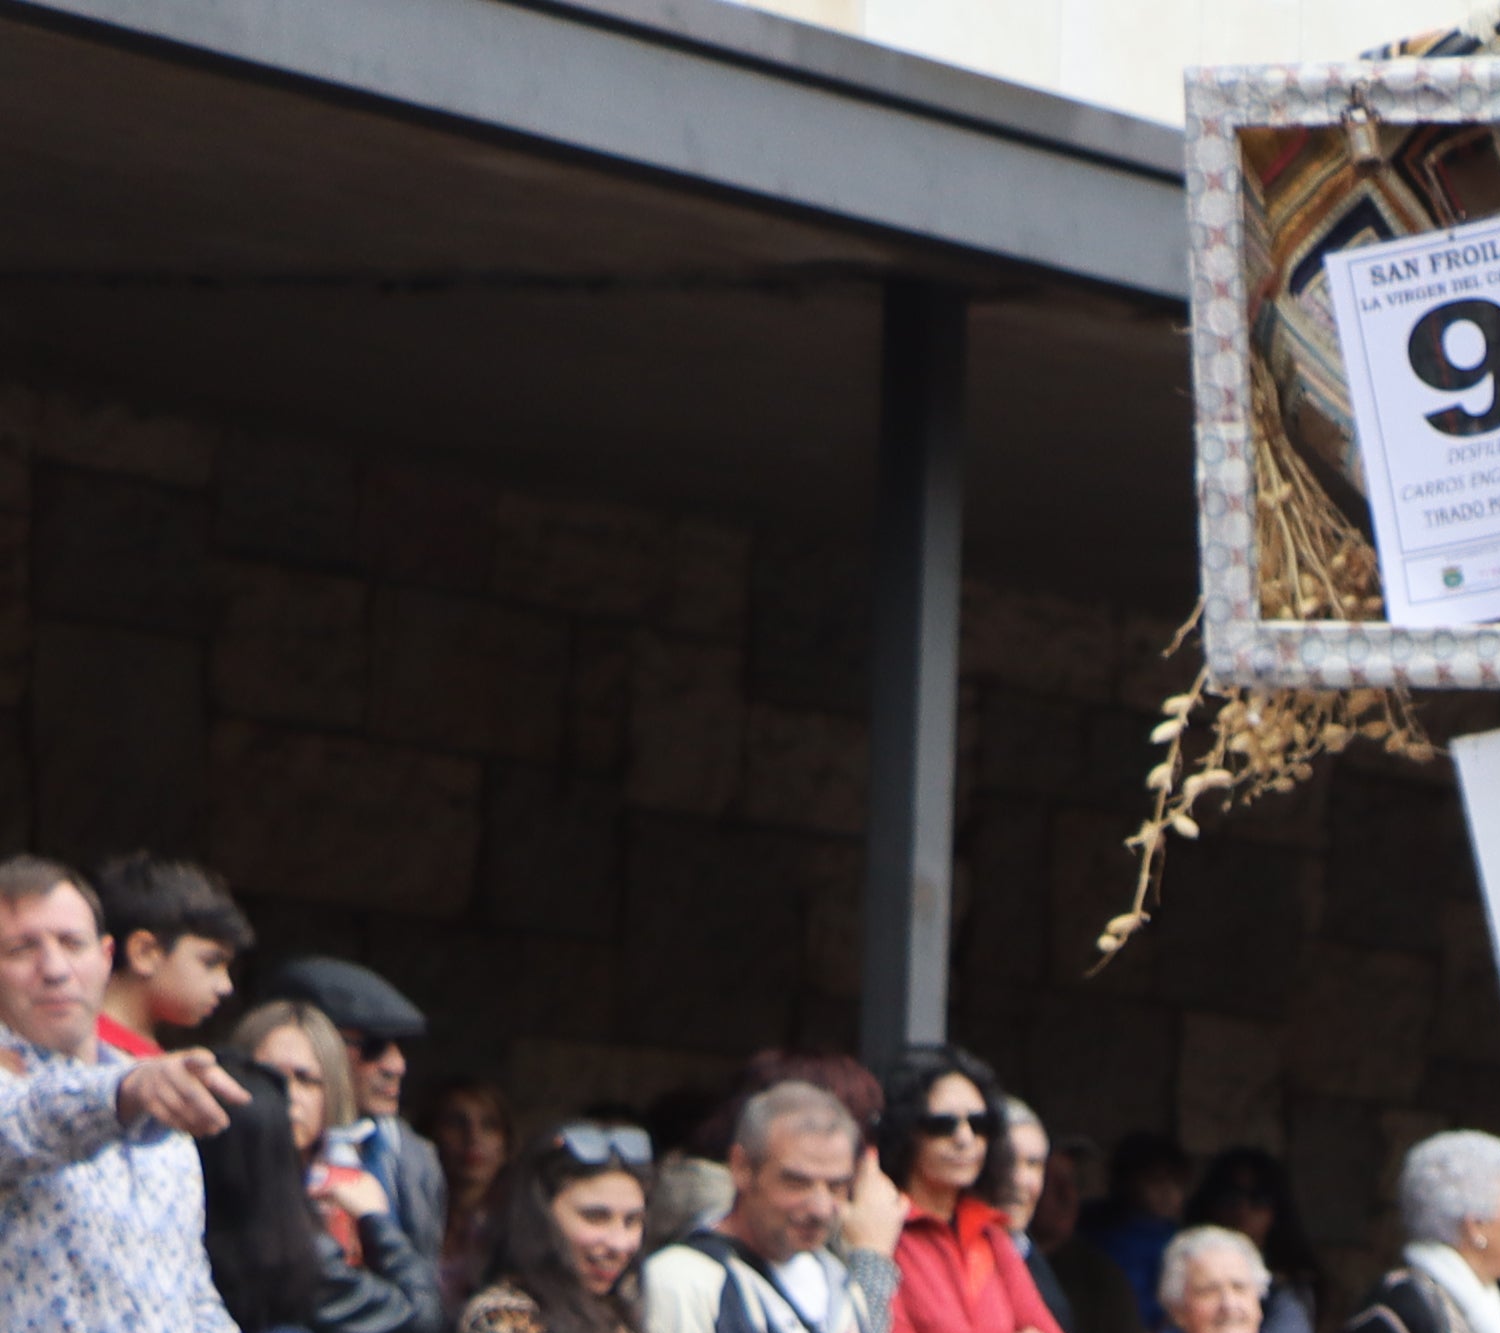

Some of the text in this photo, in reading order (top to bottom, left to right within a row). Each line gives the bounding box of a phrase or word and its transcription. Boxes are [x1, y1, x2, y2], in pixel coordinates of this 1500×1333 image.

[1370, 257, 1419, 286] SAN
[1361, 297, 1381, 312] LA
[1387, 281, 1448, 306] VIRGEN
[1453, 275, 1480, 293] DEL
[1401, 472, 1466, 502] CARROS
[1423, 499, 1485, 529] TIRADO
